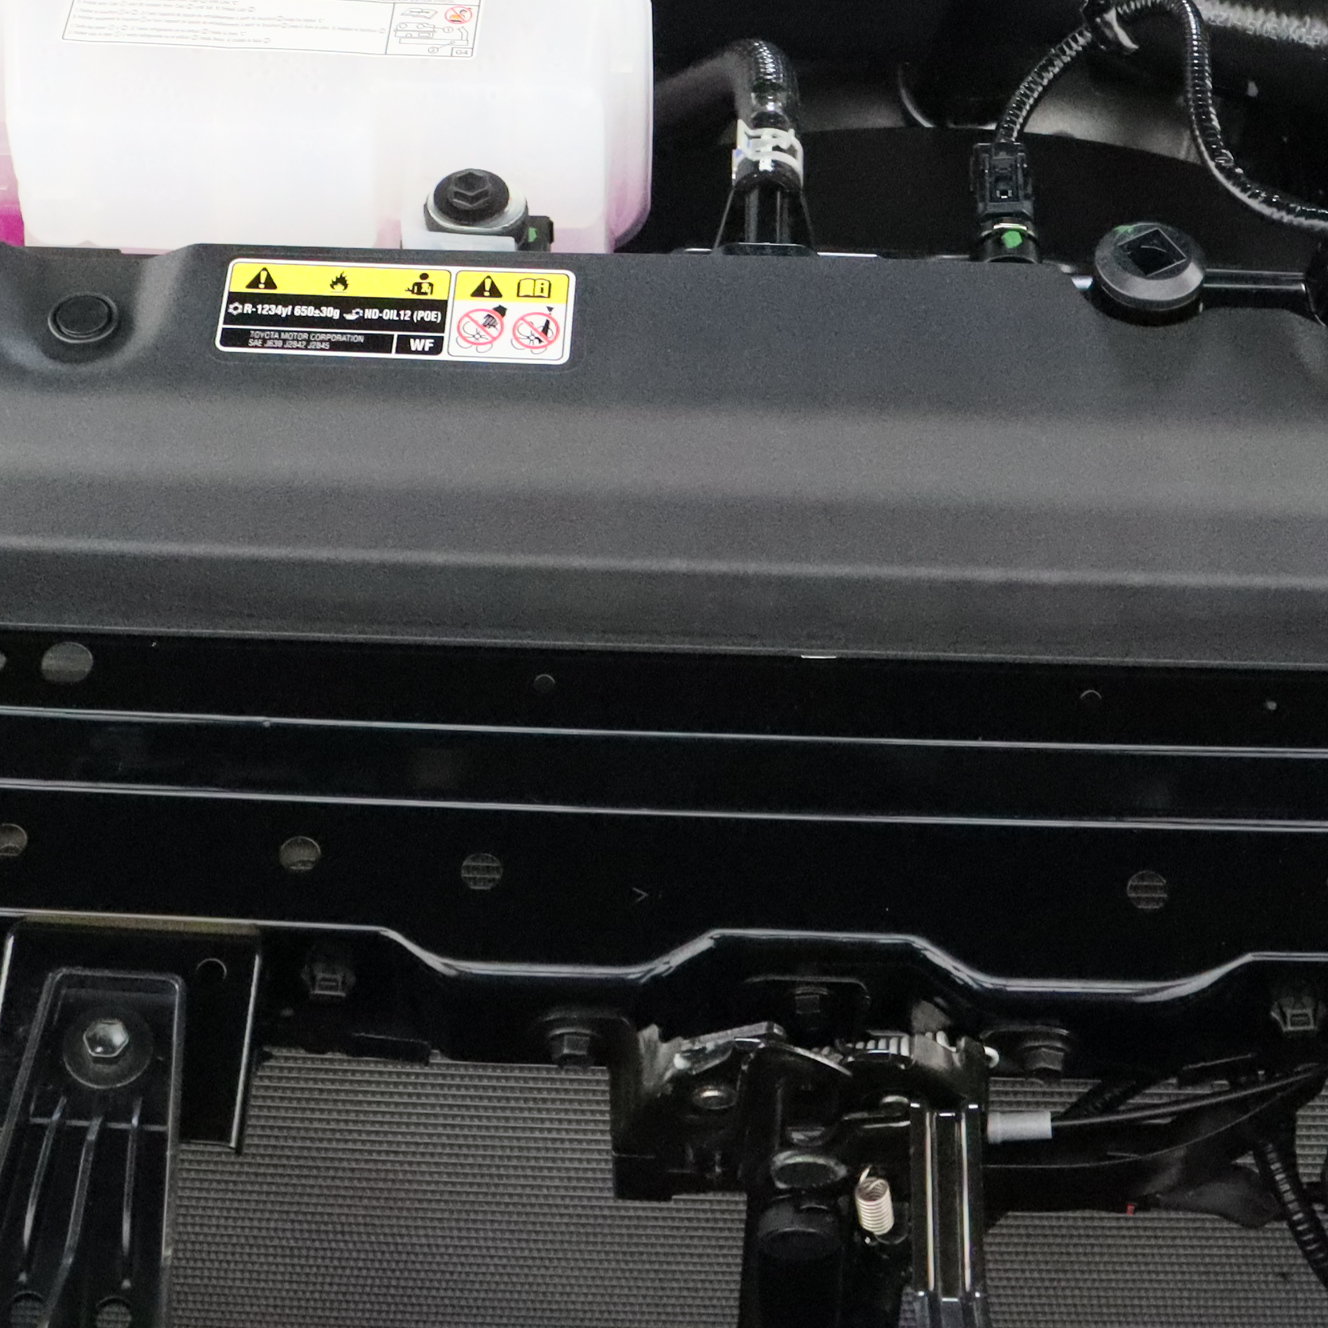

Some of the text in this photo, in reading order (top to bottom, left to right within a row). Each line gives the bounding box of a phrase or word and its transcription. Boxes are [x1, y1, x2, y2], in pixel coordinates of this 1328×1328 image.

[243, 303, 443, 324] R-1234yf 650±30g ND-OIL12 (POE)
[248, 338, 263, 347] SAE
[249, 330, 364, 343] TOYOTA MOTOR CORPORATION
[409, 338, 435, 352] WF
